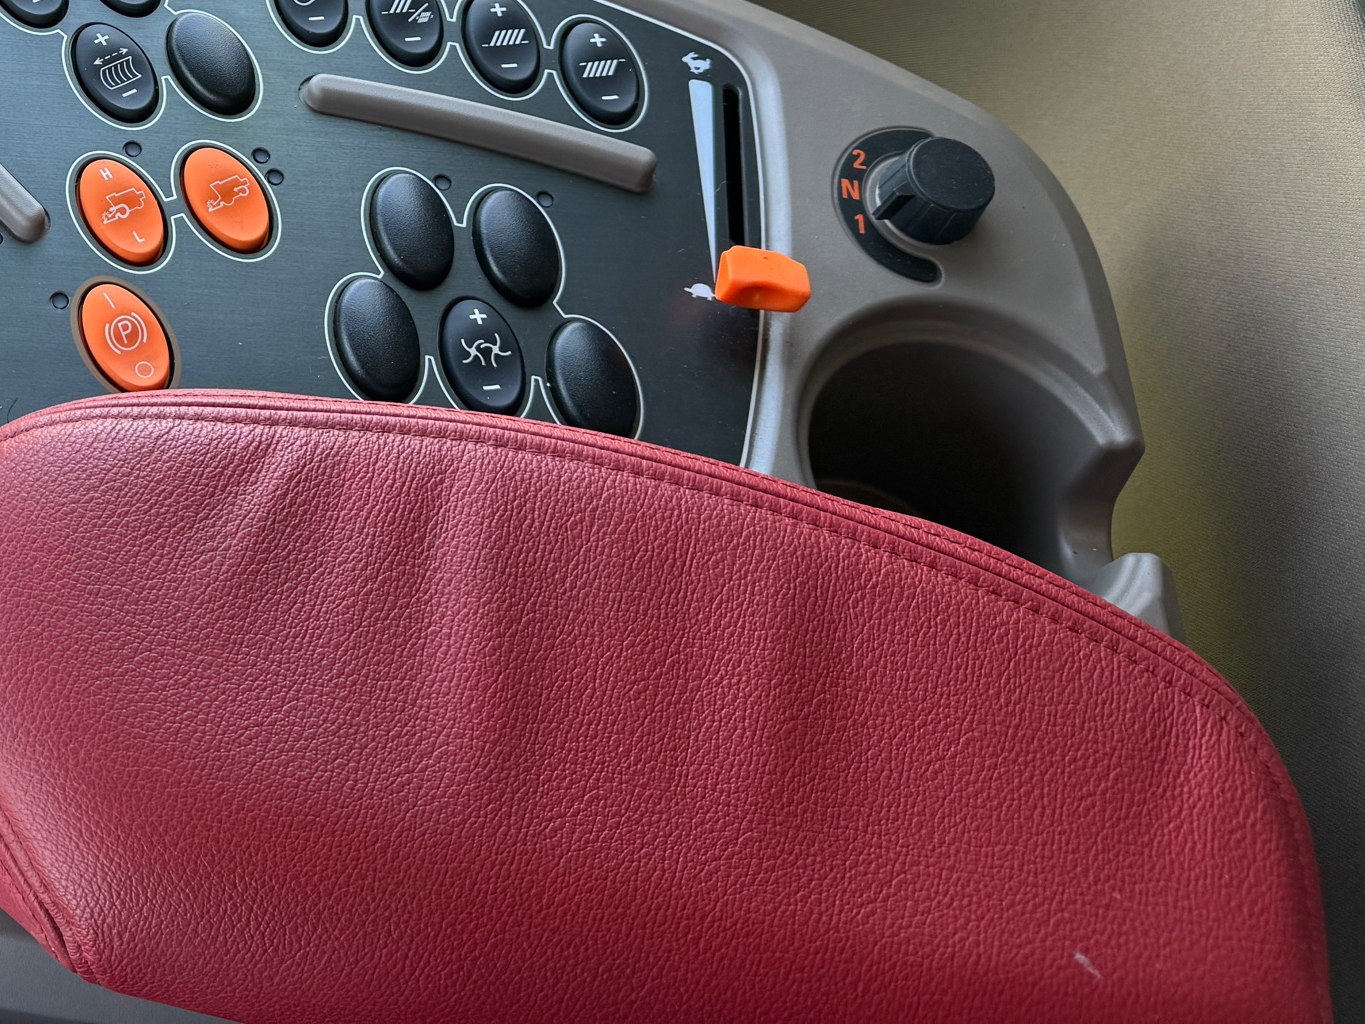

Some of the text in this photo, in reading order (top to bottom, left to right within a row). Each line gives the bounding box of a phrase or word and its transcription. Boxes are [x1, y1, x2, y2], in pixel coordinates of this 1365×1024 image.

[852, 149, 867, 170] 2
[99, 167, 113, 181] H
[841, 178, 860, 201] N
[854, 213, 866, 235] 1
[132, 231, 146, 244] L
[117, 319, 132, 344] P
